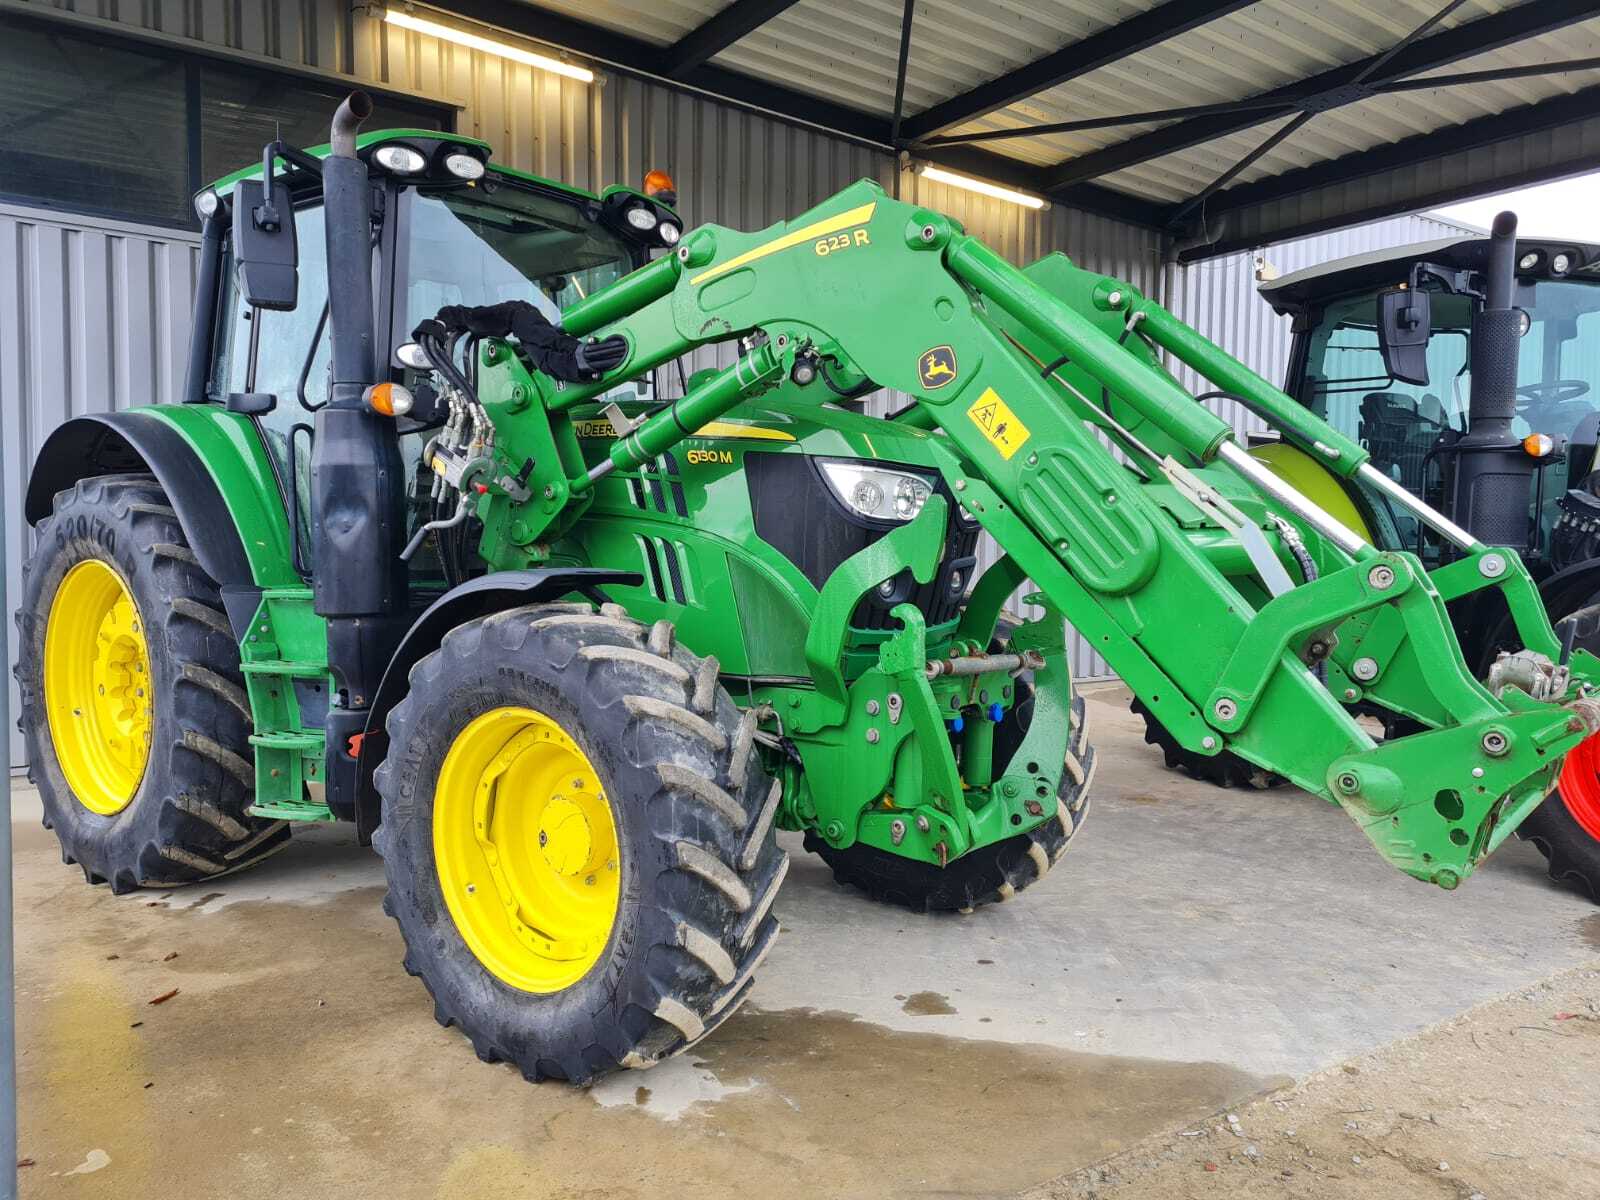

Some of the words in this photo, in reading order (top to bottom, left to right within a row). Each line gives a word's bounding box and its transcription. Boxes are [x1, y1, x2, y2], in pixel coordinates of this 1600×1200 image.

[815, 234, 851, 257] 623
[853, 228, 871, 247] R
[687, 449, 718, 465] 6130
[719, 450, 734, 464] M
